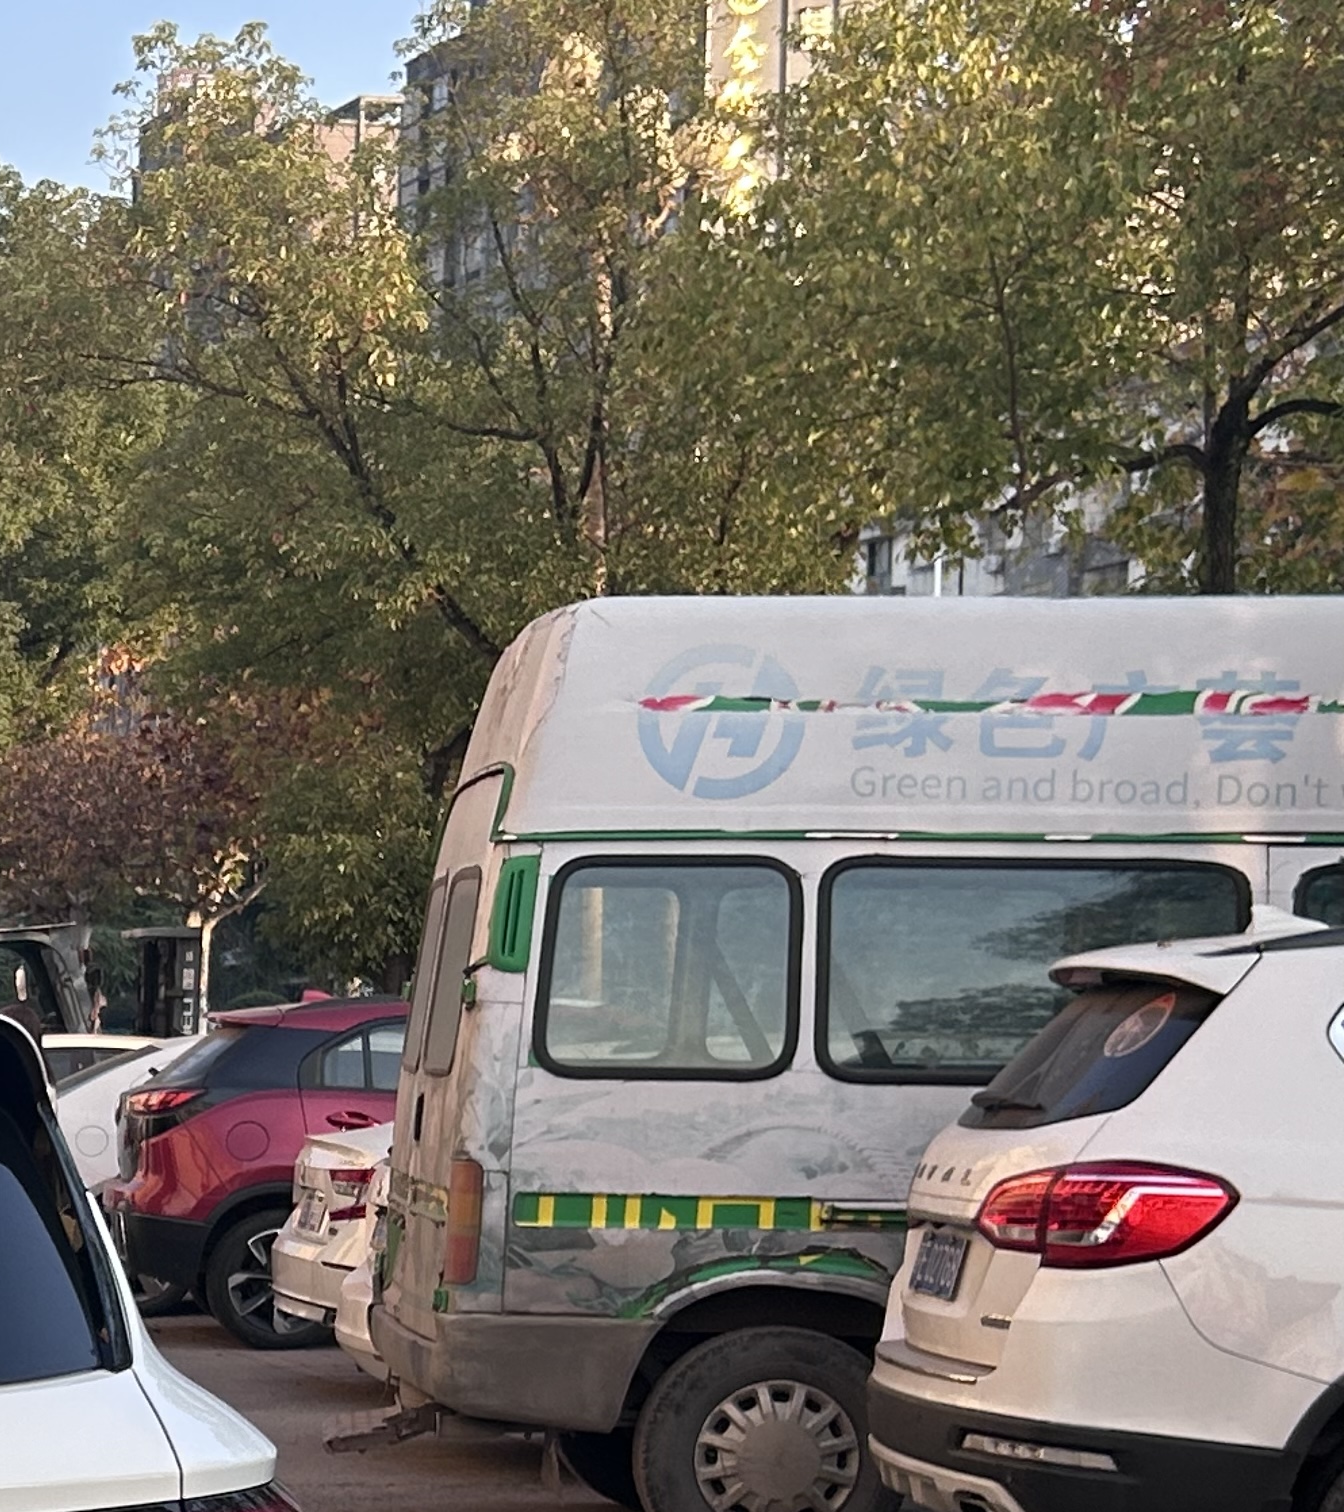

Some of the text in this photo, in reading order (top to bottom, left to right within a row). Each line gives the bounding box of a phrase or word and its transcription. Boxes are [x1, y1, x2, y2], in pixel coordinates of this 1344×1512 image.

[849, 764, 967, 800] Green
[981, 769, 1056, 802] and
[1071, 770, 1201, 808] broad,
[1216, 773, 1330, 808] Don't
